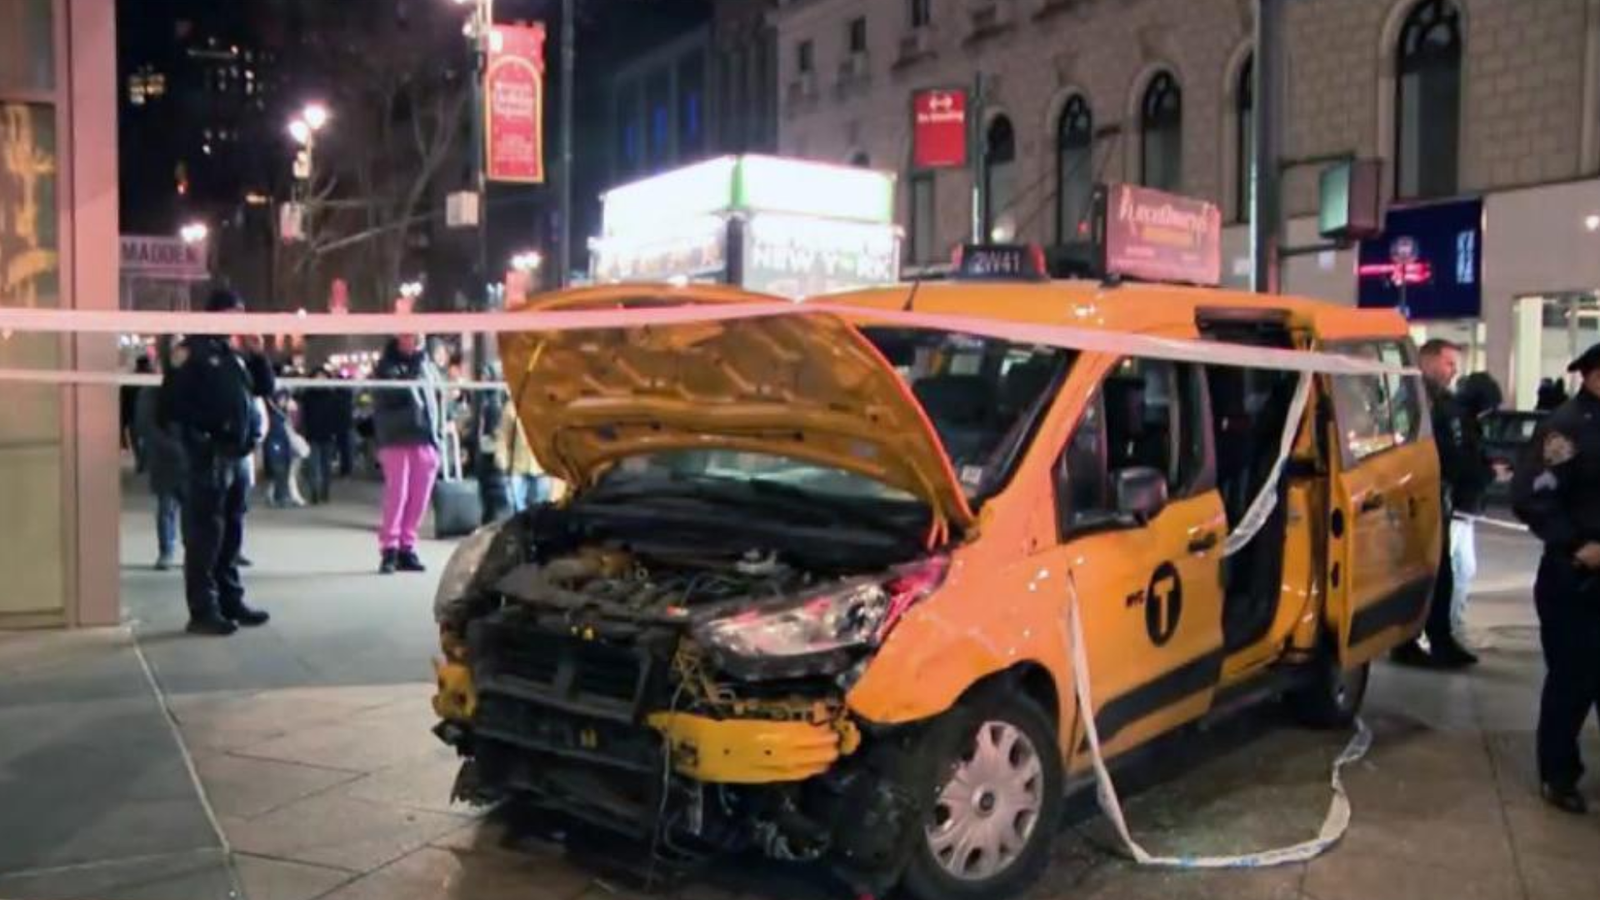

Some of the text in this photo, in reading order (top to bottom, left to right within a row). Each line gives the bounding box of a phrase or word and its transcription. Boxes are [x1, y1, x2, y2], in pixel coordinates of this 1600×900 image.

[121, 242, 200, 265] MADDEN
[753, 245, 816, 271] NEW
[973, 252, 1020, 273] 2W41
[1153, 576, 1175, 635] T
